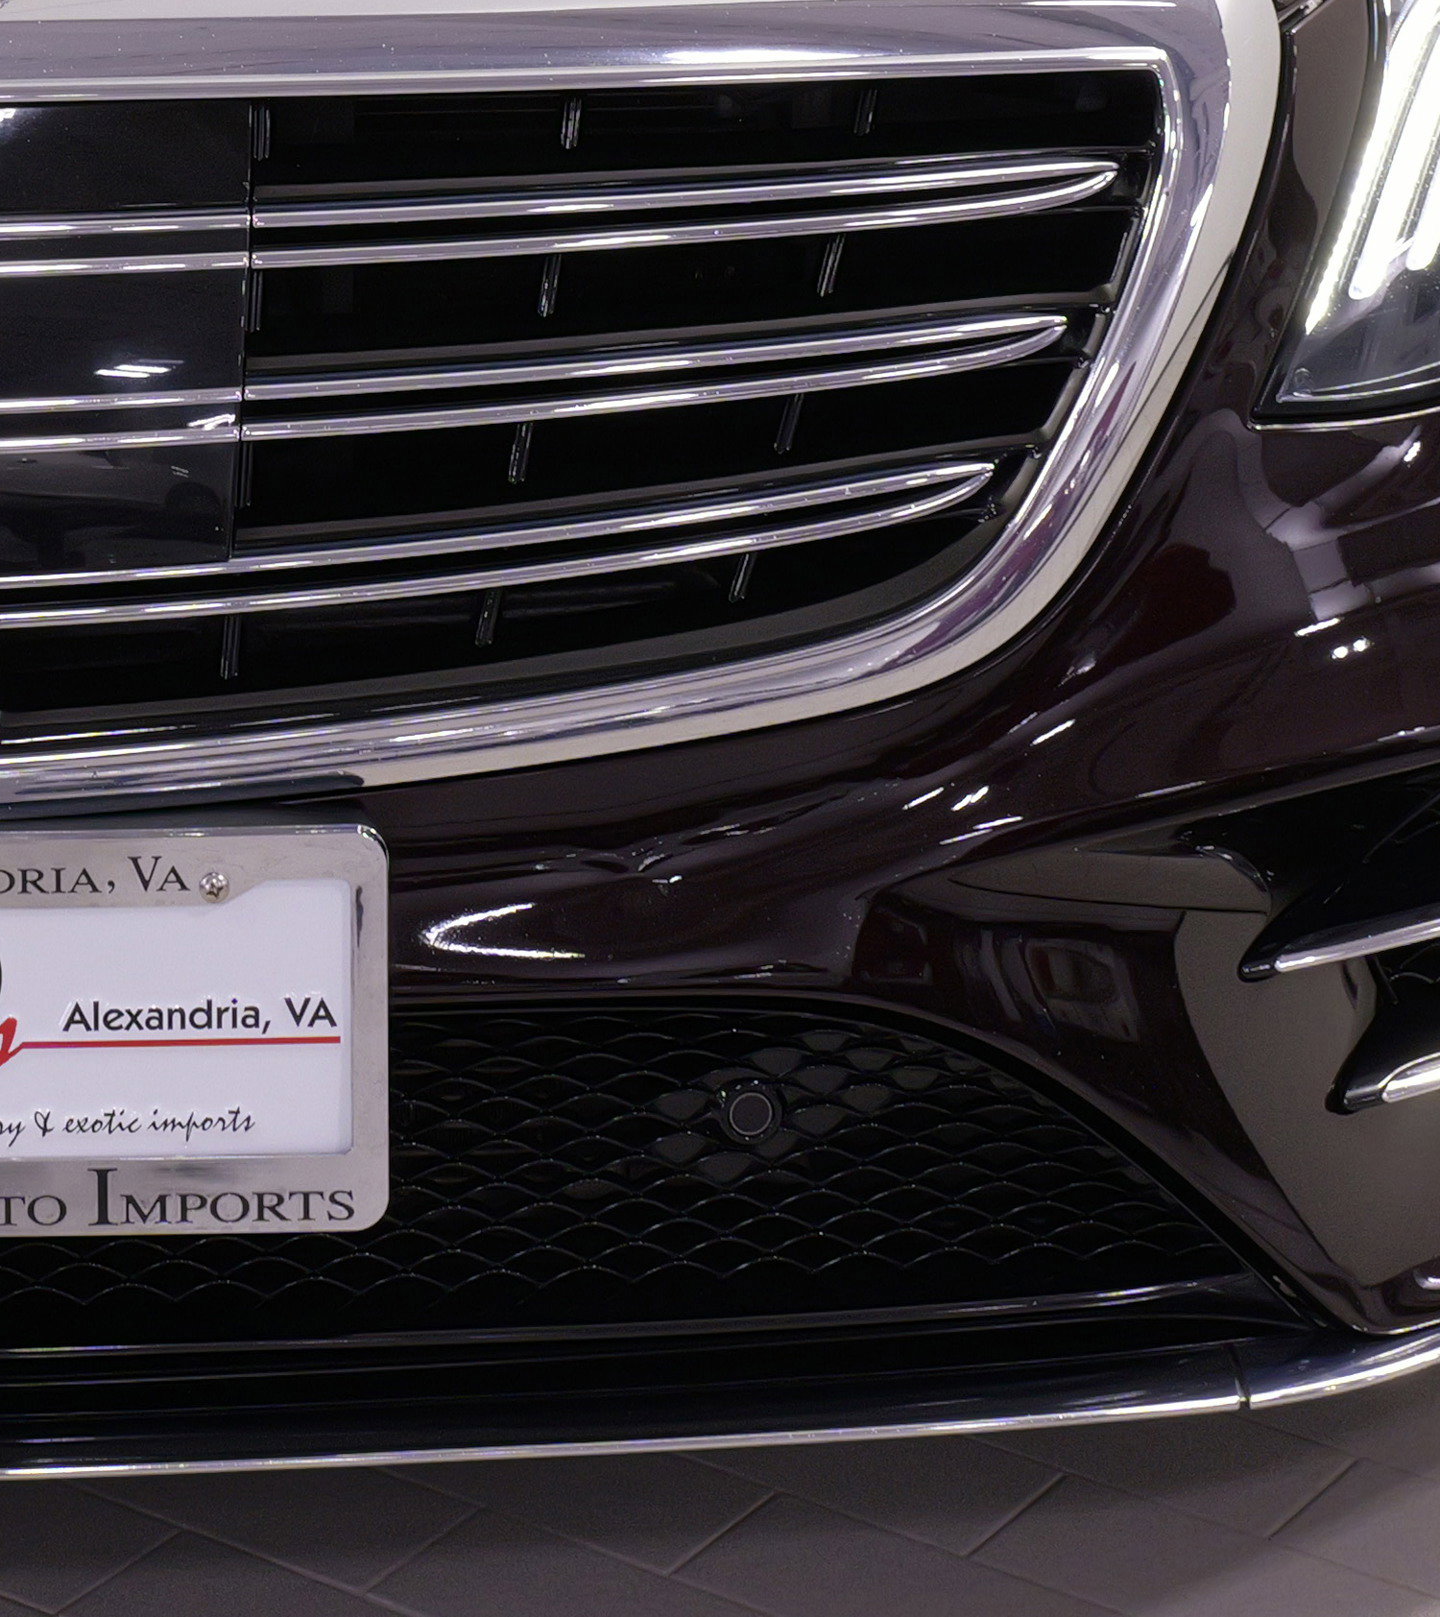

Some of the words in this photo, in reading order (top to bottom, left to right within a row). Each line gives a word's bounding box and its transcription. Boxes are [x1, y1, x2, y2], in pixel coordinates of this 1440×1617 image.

[63, 997, 272, 1035] Alexandria,
[284, 996, 338, 1028] VA
[63, 1107, 142, 1137] exotic
[149, 1107, 256, 1143] imports
